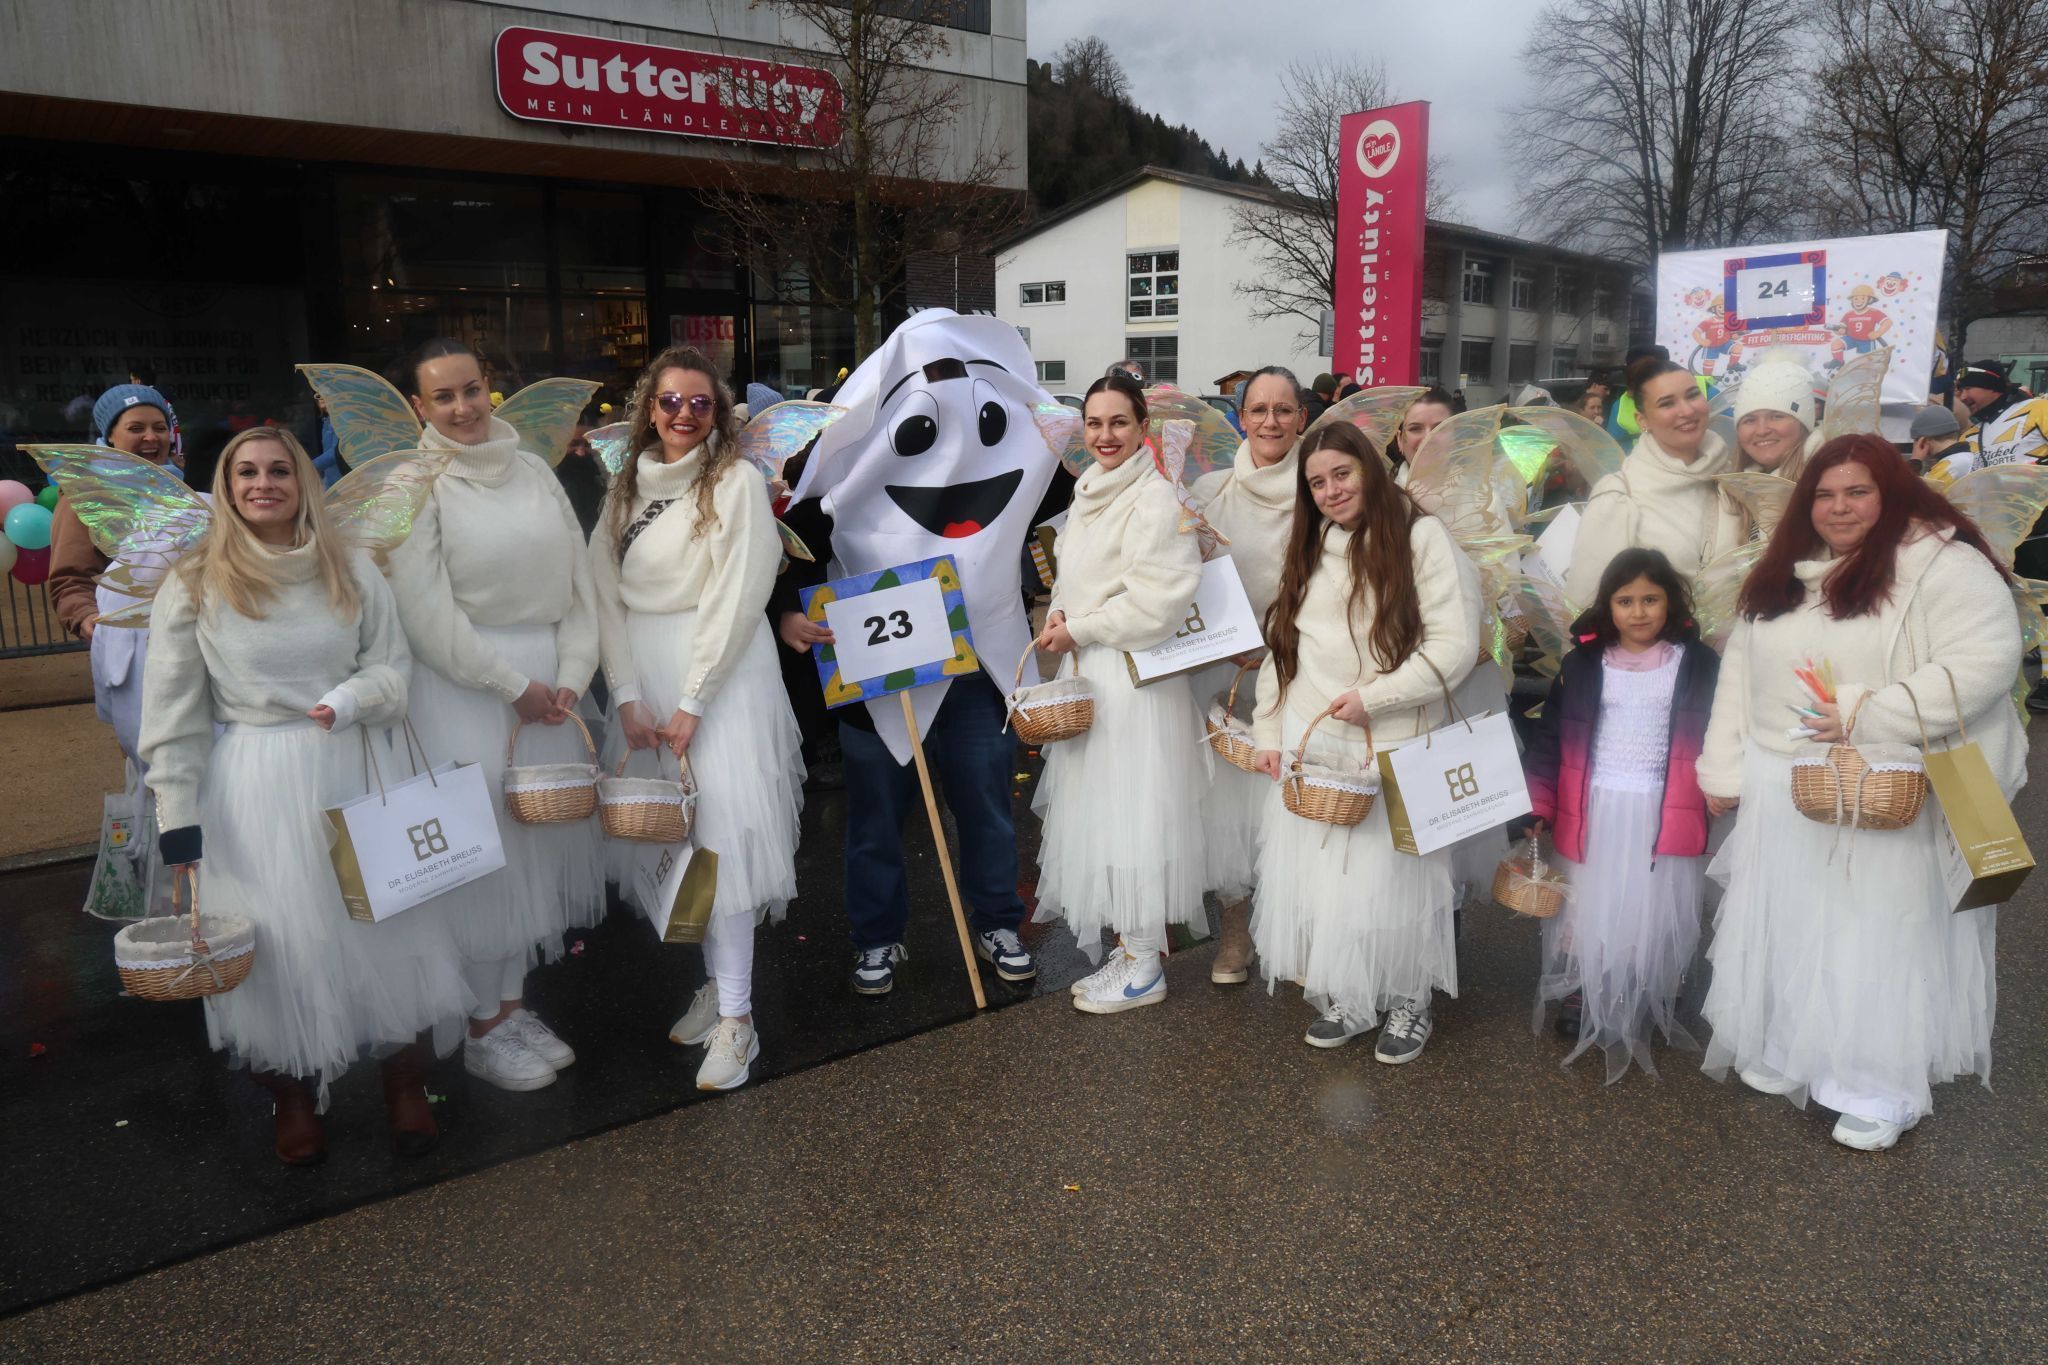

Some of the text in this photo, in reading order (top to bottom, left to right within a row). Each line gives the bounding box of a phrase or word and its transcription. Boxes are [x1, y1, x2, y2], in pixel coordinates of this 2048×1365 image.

[522, 42, 825, 124] Sutterlüty
[528, 98, 817, 140] MEIN LÄNDLEMARK
[1367, 142, 1391, 158] LÄNDLE
[1356, 189, 1384, 386] Sutterlüty
[1758, 280, 1789, 299] 24
[20, 328, 254, 348] HERZLICH WILLKOMMEN
[1716, 328, 1724, 339] 9
[1855, 321, 1863, 333] 9
[1748, 335, 1759, 345] FIT
[20, 355, 260, 375] BEIM WELTMEISTER FÜR
[864, 610, 913, 647] 23
[1165, 636, 1207, 654] ELISABETH
[1208, 625, 1239, 642] BREUSS
[1442, 801, 1480, 820] ELISABETH
[1480, 789, 1509, 806] BREUSS
[404, 858, 450, 882] ELISABETH
[450, 844, 482, 863] BREUSS
